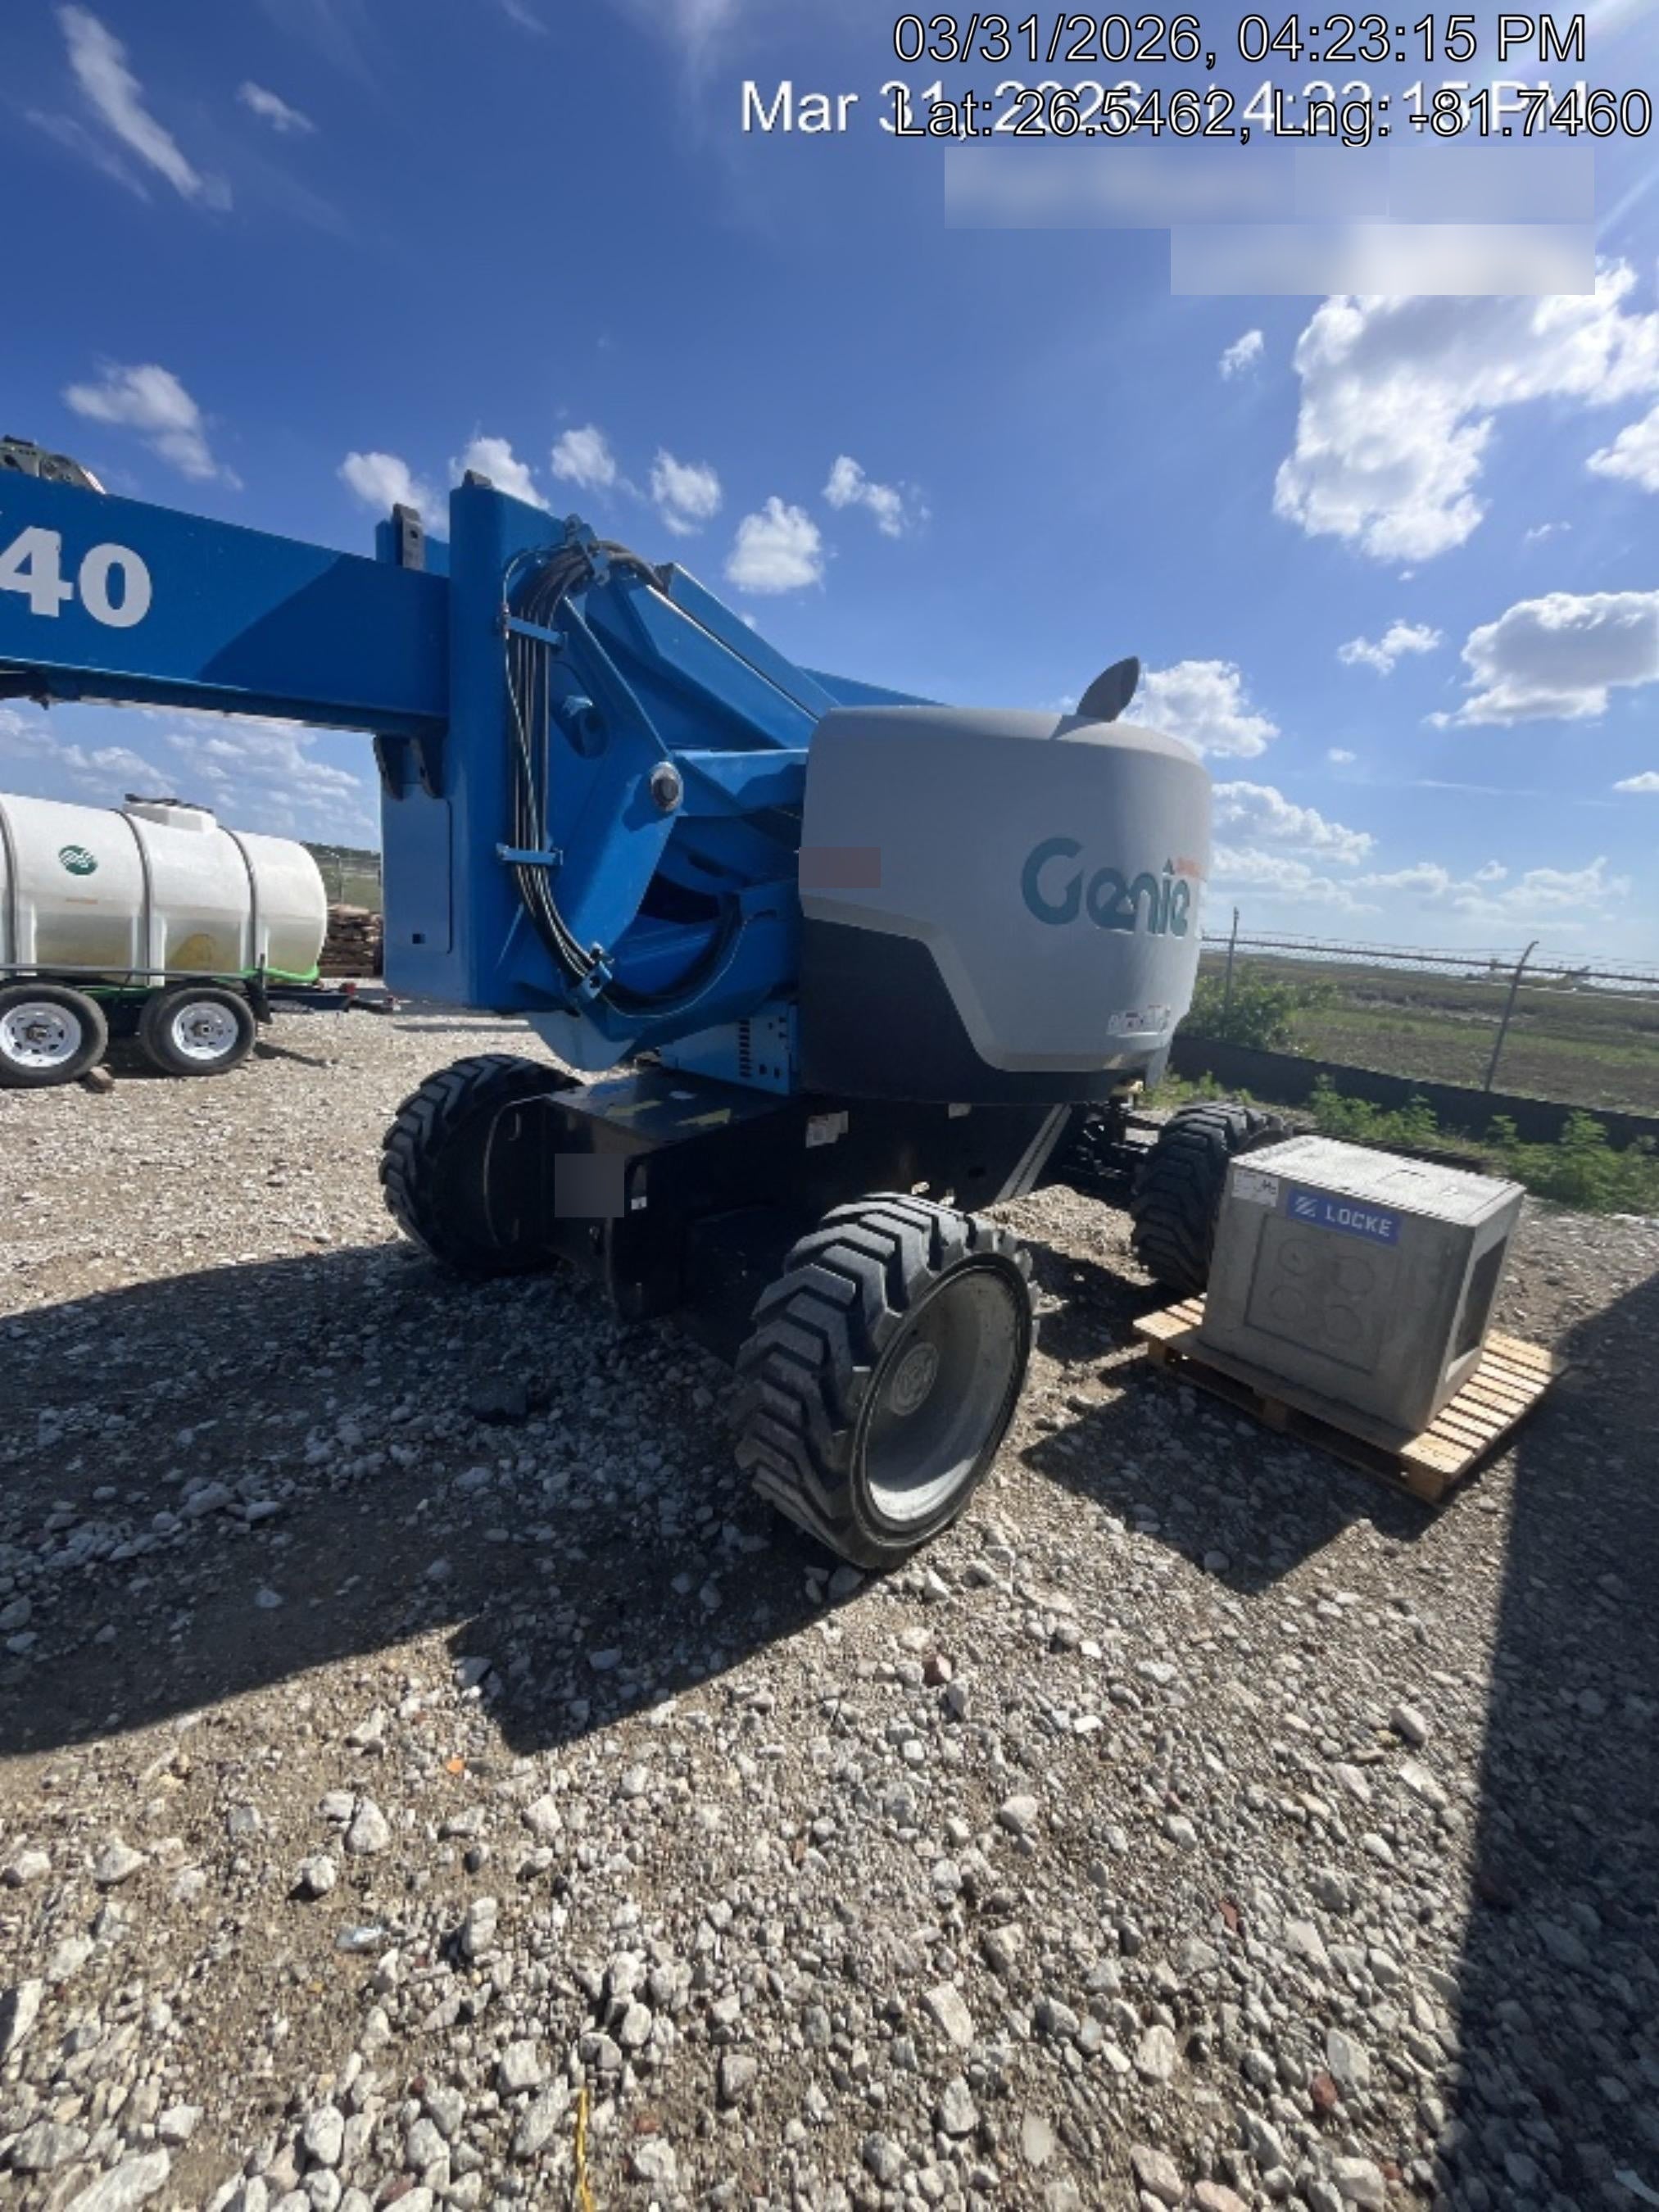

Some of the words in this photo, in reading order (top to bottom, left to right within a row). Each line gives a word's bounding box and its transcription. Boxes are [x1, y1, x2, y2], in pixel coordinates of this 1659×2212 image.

[0, 525, 152, 628] 40
[1021, 837, 1190, 936] Genie
[1325, 1204, 1392, 1237] LOCKE
